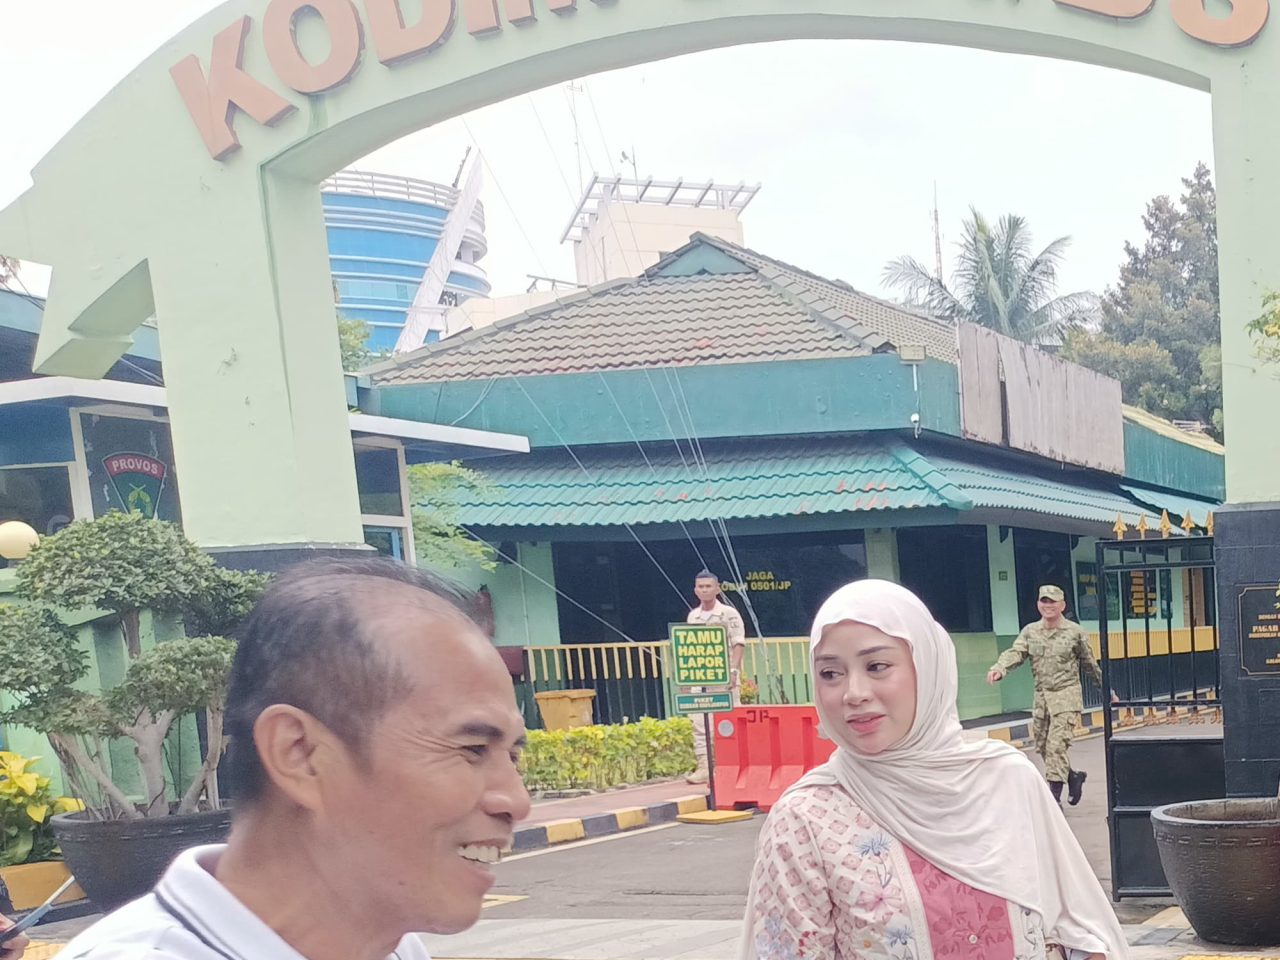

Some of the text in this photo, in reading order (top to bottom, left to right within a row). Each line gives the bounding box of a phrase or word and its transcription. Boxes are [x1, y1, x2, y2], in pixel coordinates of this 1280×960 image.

[111, 458, 159, 475] PROVOS
[746, 571, 774, 580] JAGA
[751, 581, 791, 591] 0501/JP
[676, 630, 722, 644] TAMU
[678, 645, 724, 656] HARAP
[679, 657, 725, 668] LAPOR
[680, 669, 725, 680] PIKET
